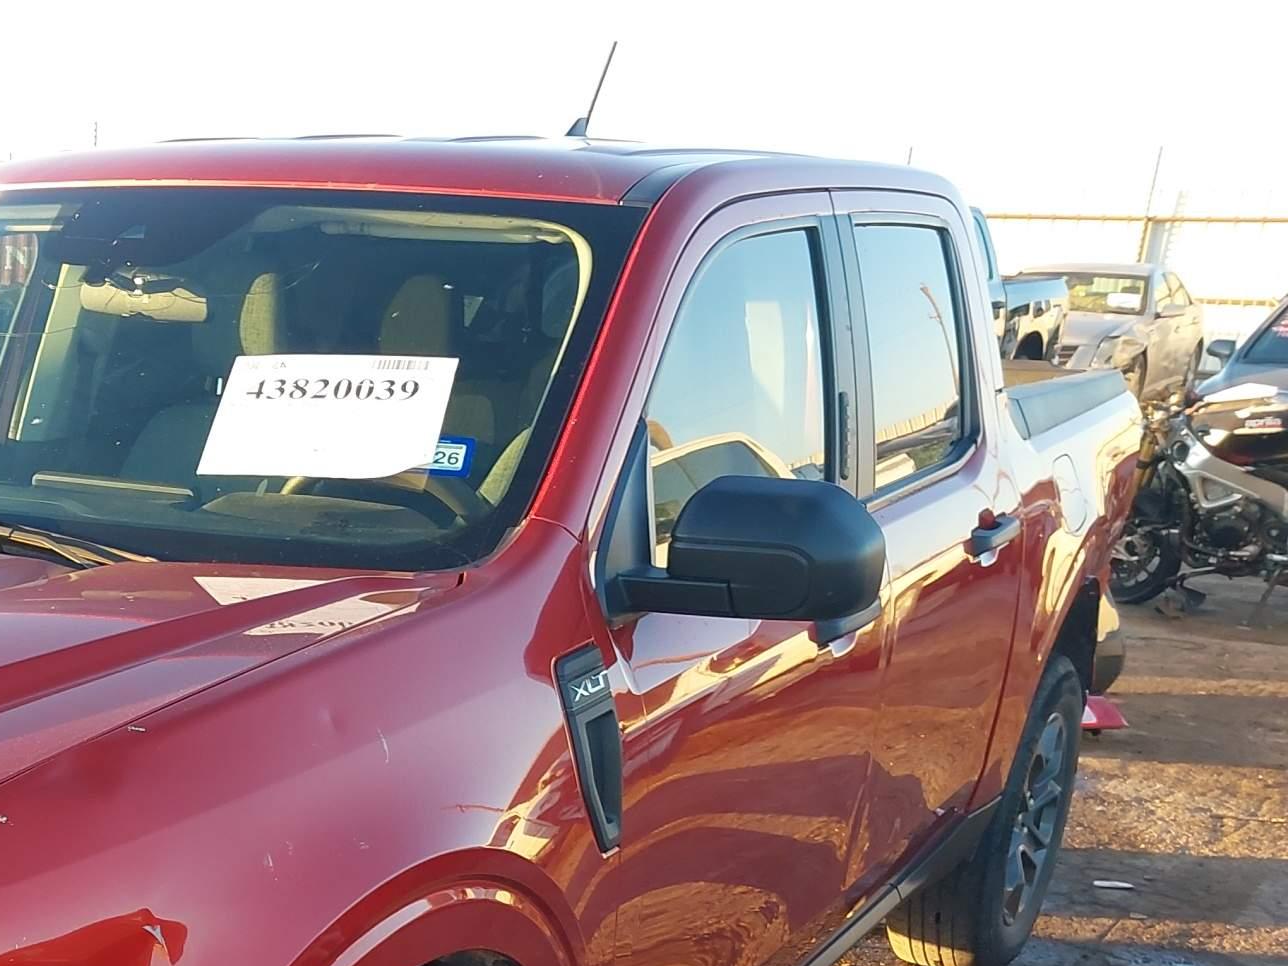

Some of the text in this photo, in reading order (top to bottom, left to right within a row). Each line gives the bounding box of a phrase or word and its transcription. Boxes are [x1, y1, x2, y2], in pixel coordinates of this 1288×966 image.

[246, 377, 420, 401] 43820039
[432, 450, 460, 466] 26
[570, 669, 609, 702] XLT
